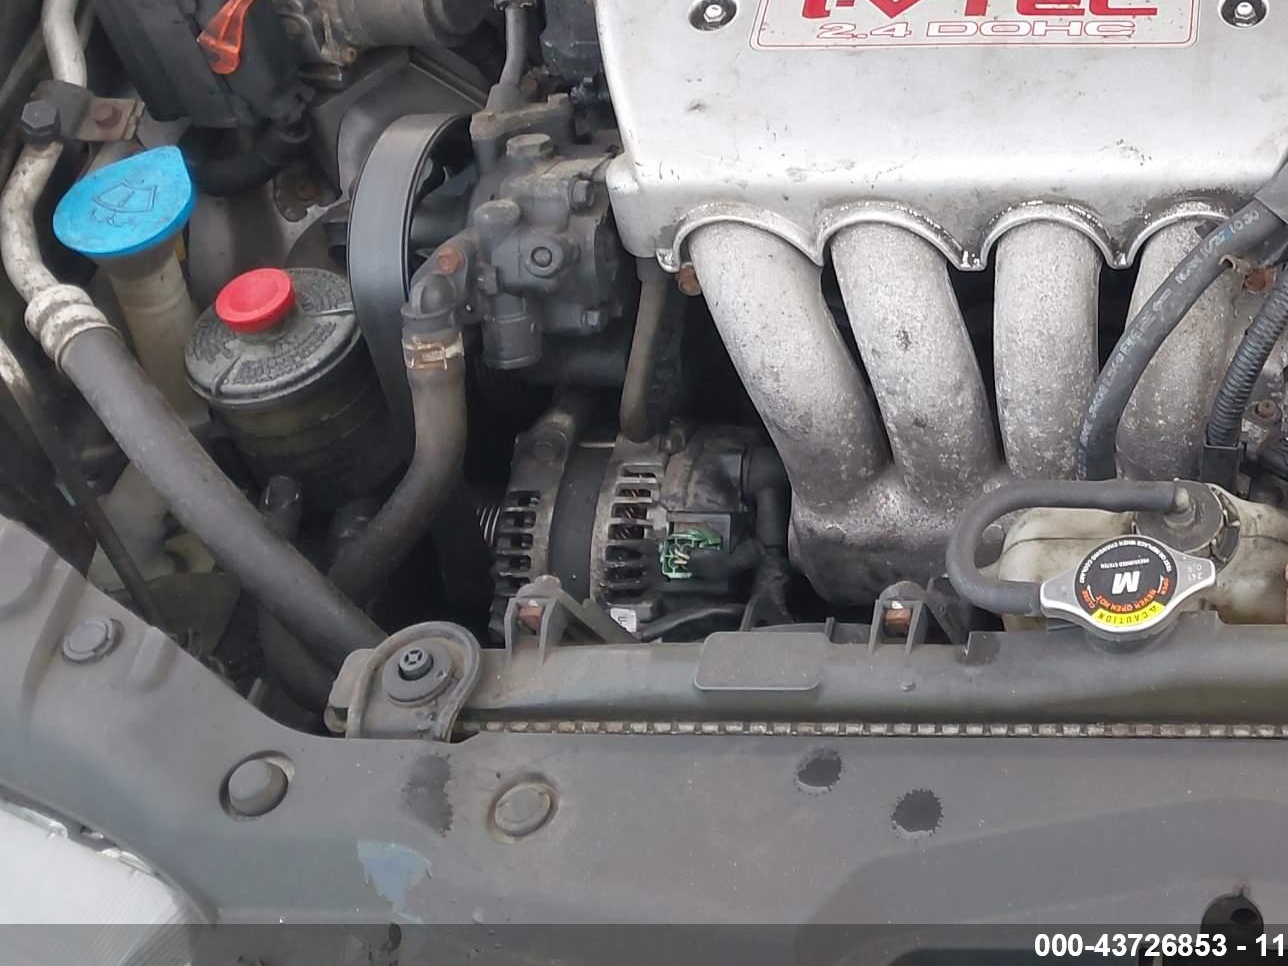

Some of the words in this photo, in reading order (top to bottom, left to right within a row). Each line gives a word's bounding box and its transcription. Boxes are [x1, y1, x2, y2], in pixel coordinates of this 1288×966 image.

[816, 20, 912, 39] 2.4
[925, 20, 1137, 38] DOHC
[1112, 571, 1140, 594] M
[1097, 611, 1150, 623] CAUTION
